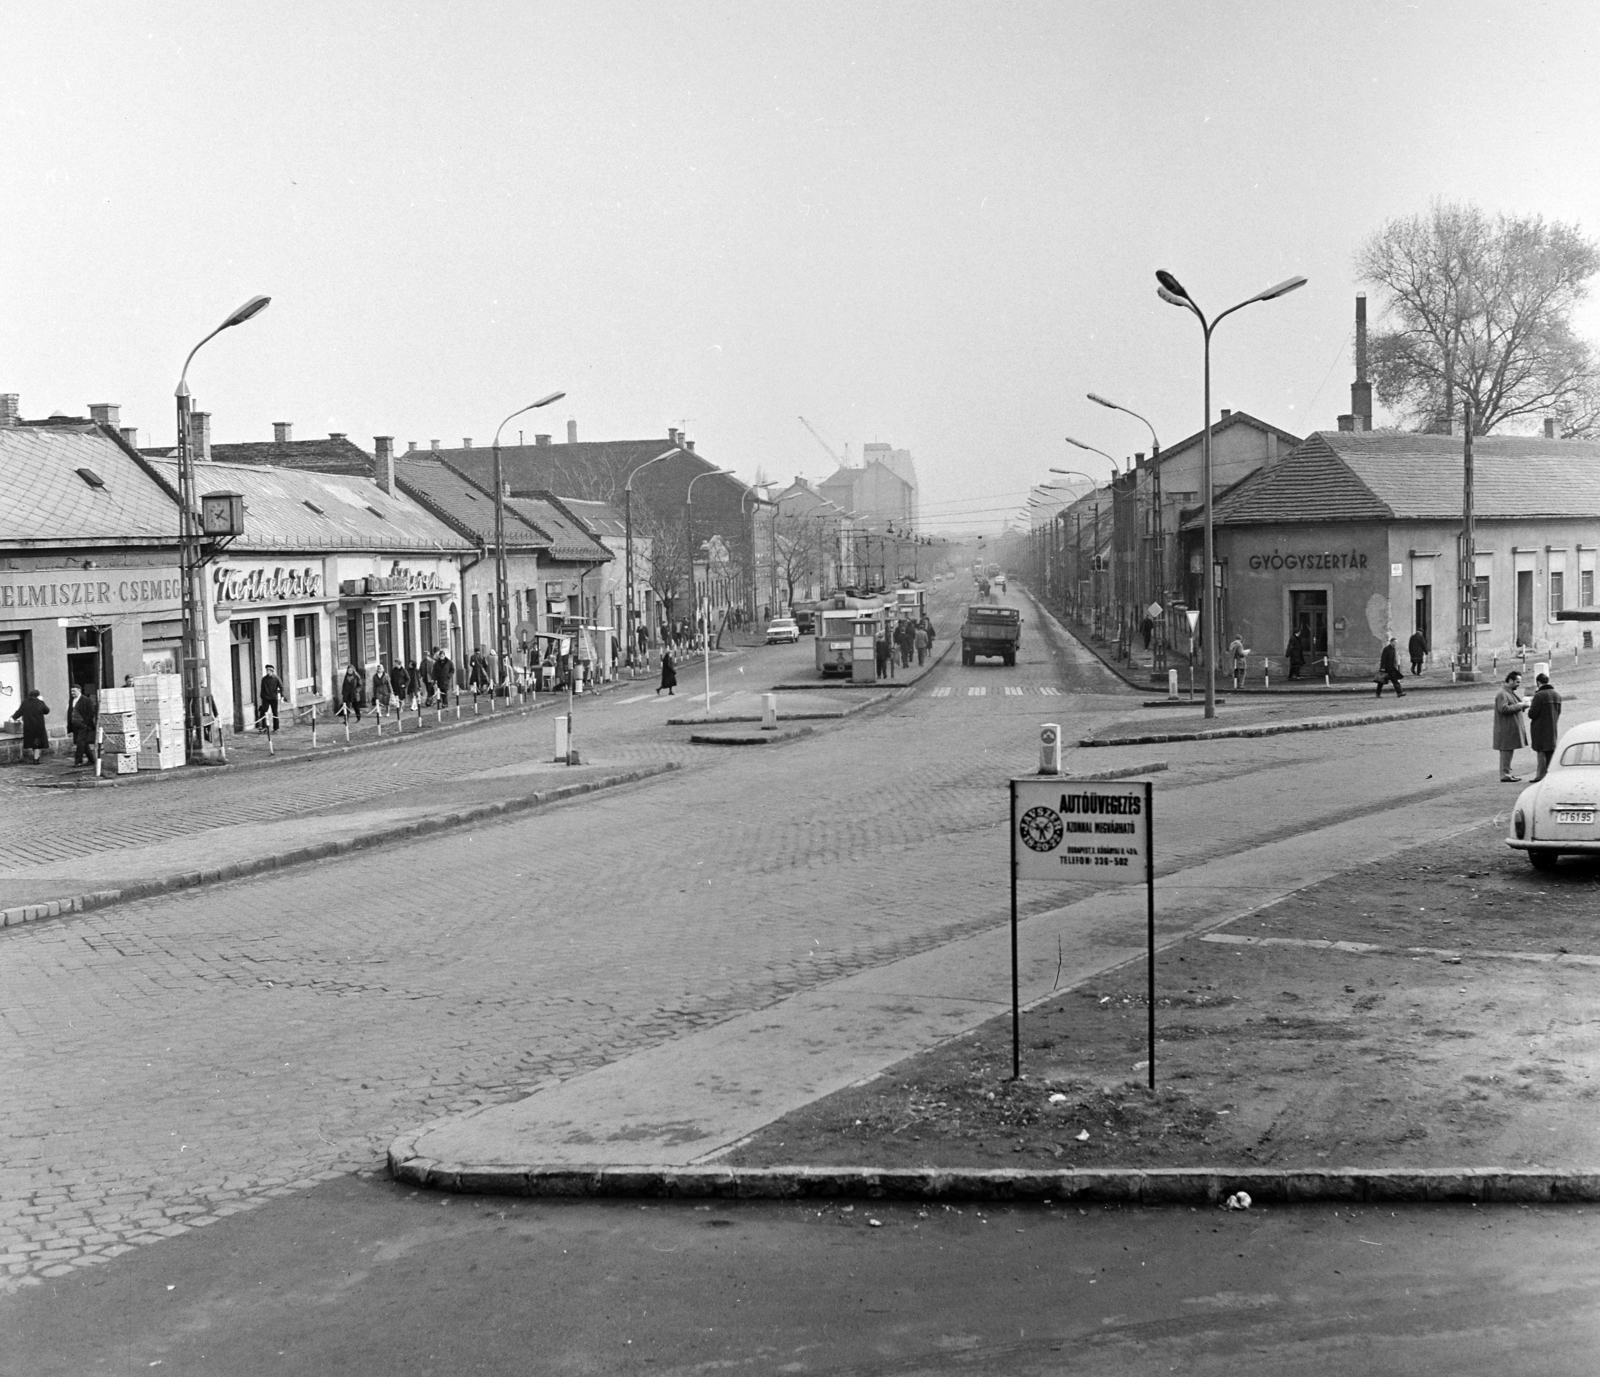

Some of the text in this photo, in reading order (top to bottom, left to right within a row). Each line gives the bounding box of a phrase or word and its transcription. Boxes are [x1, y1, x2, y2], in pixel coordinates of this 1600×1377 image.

[1249, 549, 1368, 570] GYÓGYSZERTÁR
[0, 581, 111, 608] ELMISZER
[1059, 791, 1141, 815] AUTÓÜVEGEZÉS
[1021, 807, 1062, 831] JAVSZER
